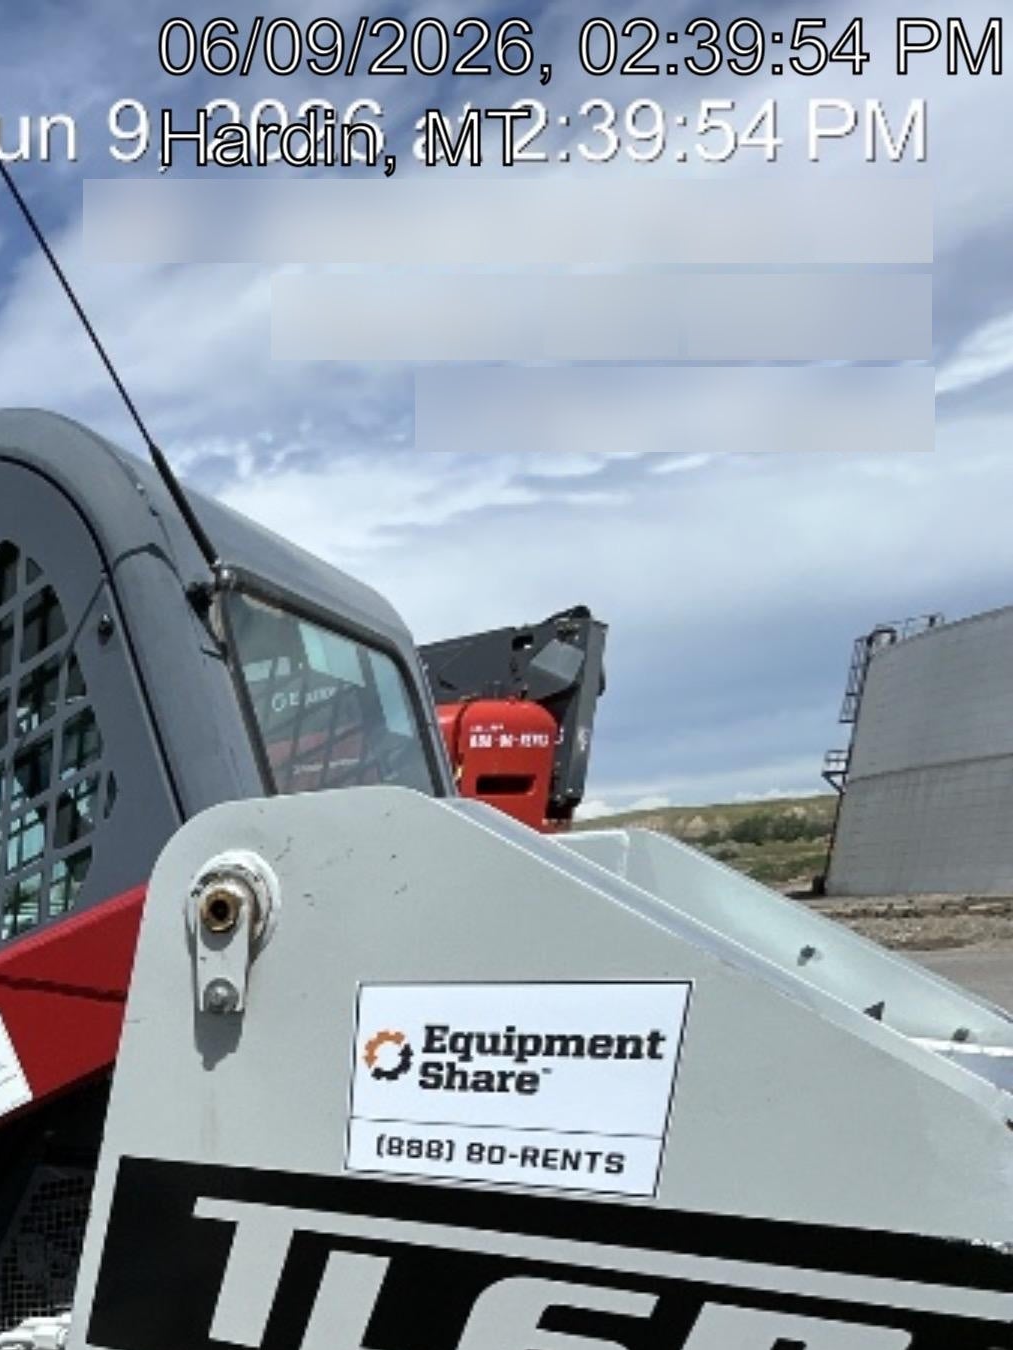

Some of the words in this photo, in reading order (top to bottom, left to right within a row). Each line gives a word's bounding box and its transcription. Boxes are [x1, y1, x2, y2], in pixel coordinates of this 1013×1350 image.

[421, 1024, 666, 1063] Equipment
[375, 1134, 454, 1161] (888)
[466, 1142, 626, 1175] 80-RENTS
